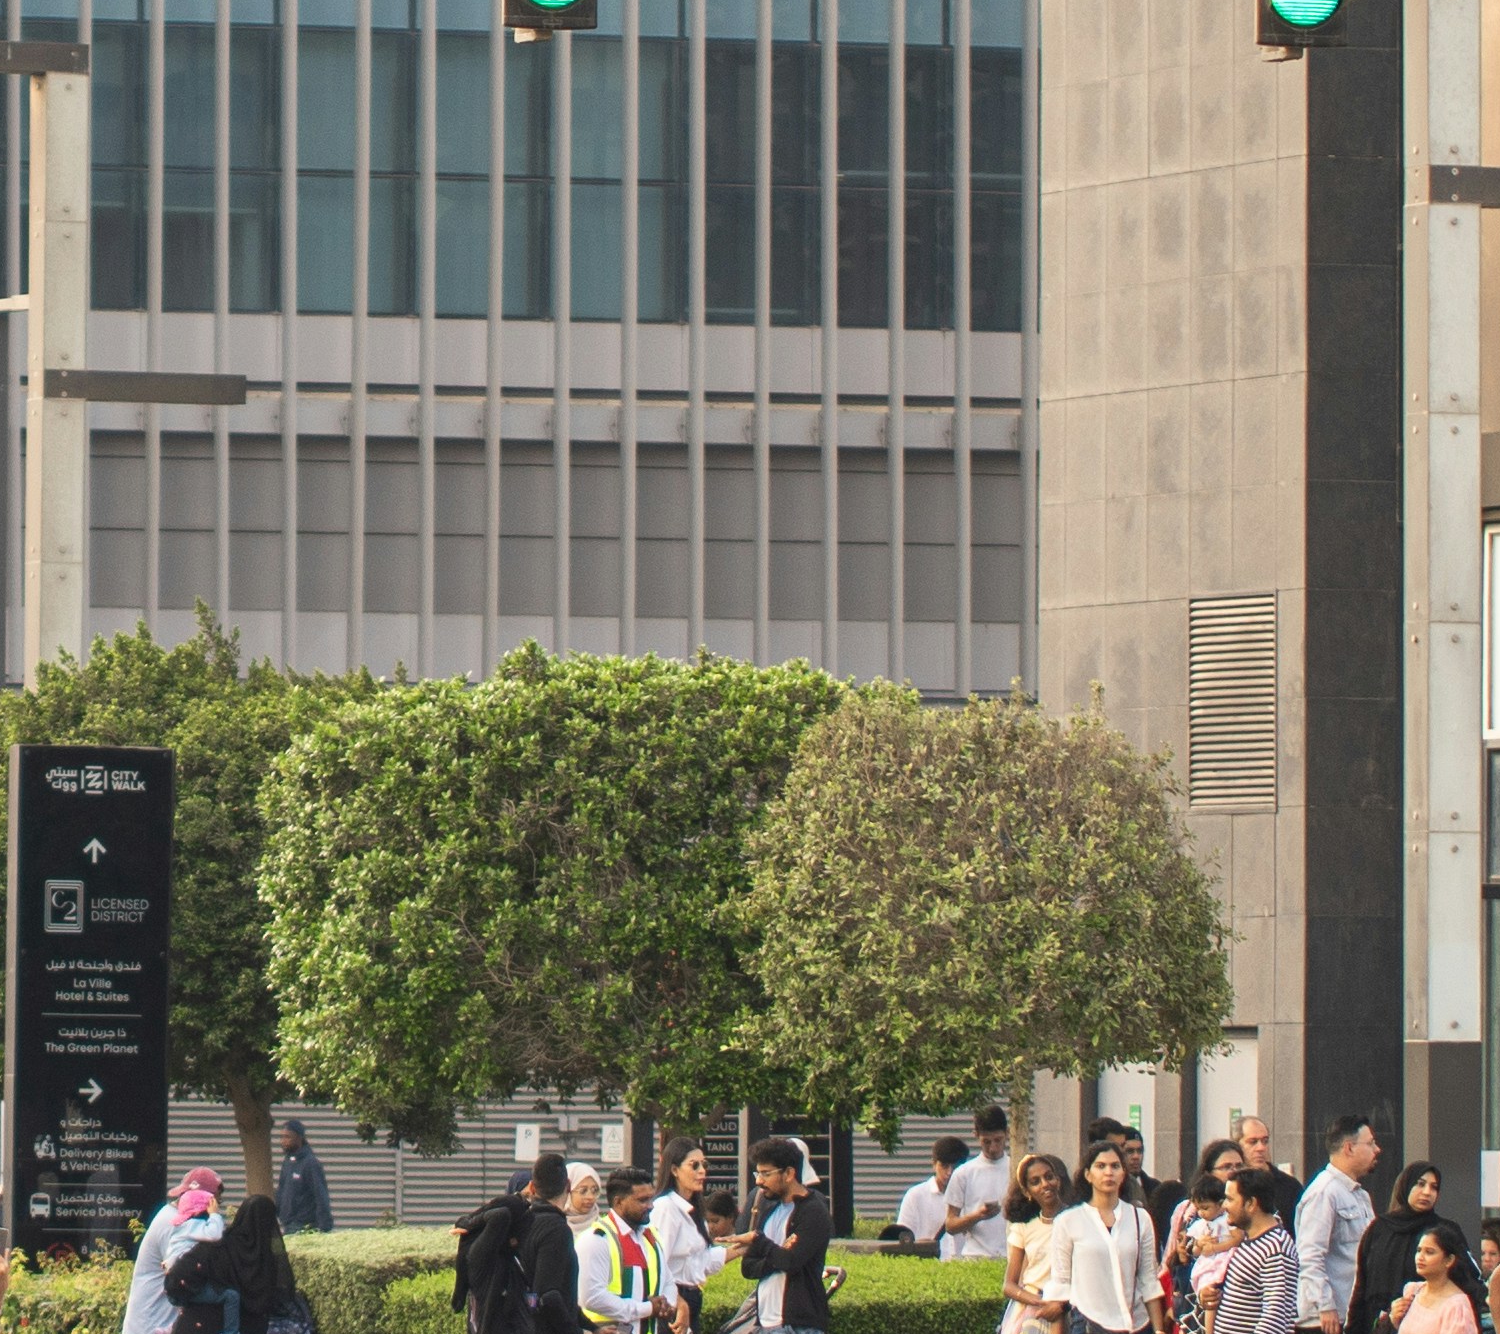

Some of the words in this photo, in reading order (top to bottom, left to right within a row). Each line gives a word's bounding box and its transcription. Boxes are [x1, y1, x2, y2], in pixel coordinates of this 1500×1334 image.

[45, 767, 78, 782] سيتي
[111, 770, 139, 780] CITY
[52, 778, 78, 792] ووك
[112, 780, 146, 791] WALK
[91, 898, 149, 910] LICENSED
[91, 910, 145, 922] DISTRICT
[45, 960, 67, 971] فيل
[115, 961, 142, 972] فندق
[73, 978, 87, 988] La
[89, 978, 113, 988] Ville
[55, 991, 85, 1001] Hotel
[86, 992, 94, 1001] &
[96, 992, 130, 1002] Suites
[45, 1043, 65, 1052] The
[67, 1043, 100, 1053] Green
[103, 1044, 138, 1054] Planet
[60, 1148, 103, 1160] Delivery
[105, 1149, 134, 1159] Bikes
[60, 1162, 68, 1171] &
[70, 1161, 115, 1171] Vehicles
[56, 1207, 96, 1217] Service
[99, 1208, 142, 1219] Delivery
